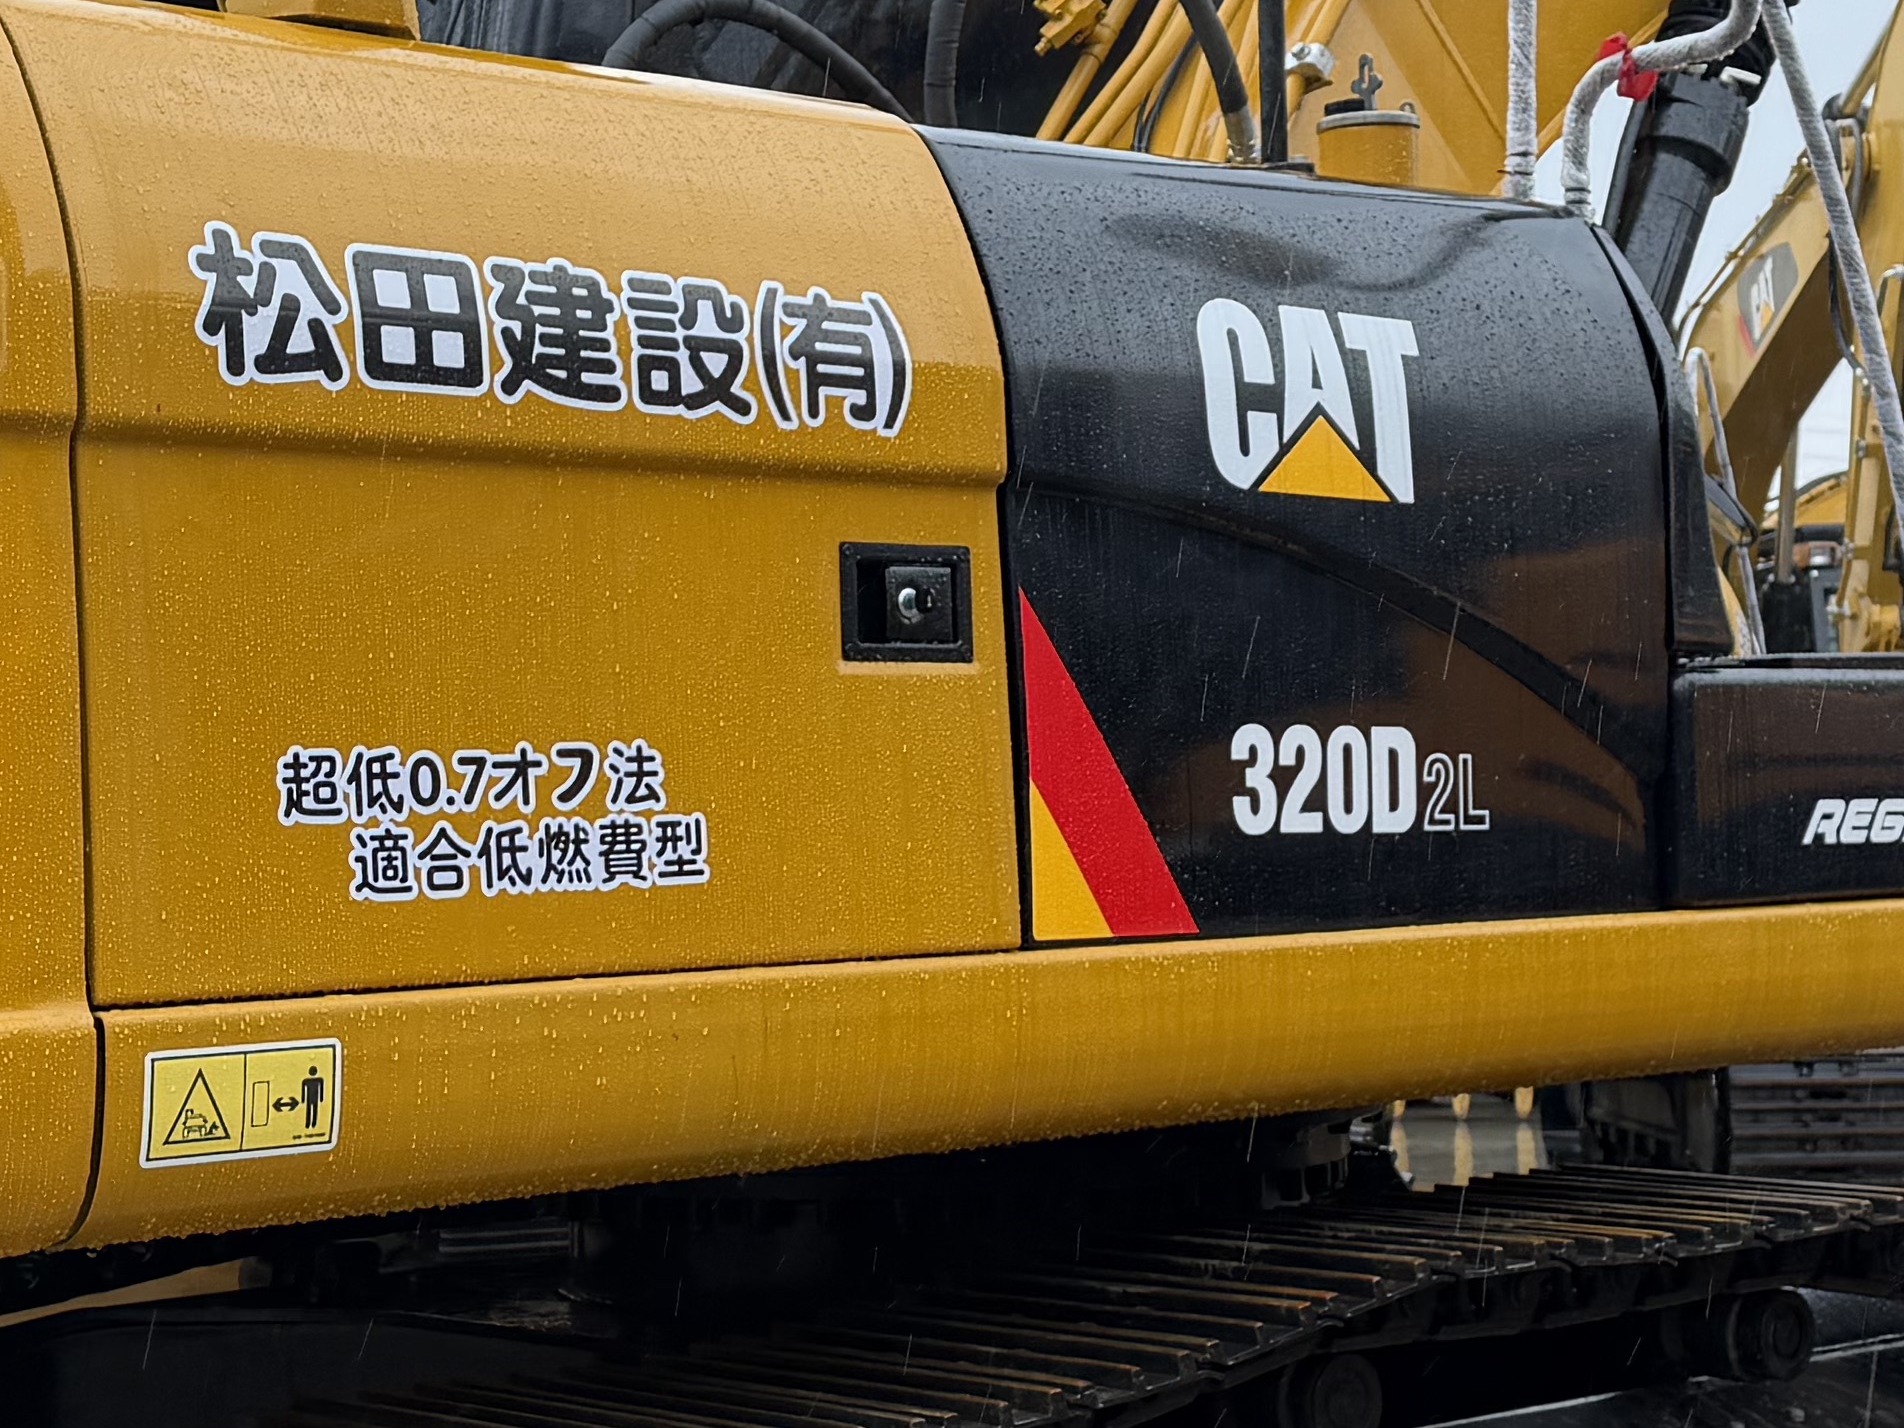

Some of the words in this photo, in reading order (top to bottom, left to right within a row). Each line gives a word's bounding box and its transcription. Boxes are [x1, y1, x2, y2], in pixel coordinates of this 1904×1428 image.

[189, 220, 912, 437] 松田建設(有)
[1197, 298, 1420, 504] CAT
[278, 739, 666, 825] 超低0.7オフ法
[1230, 723, 1416, 836] 320D
[1423, 753, 1490, 833] 2L
[349, 814, 710, 902] 適合低燃費型
